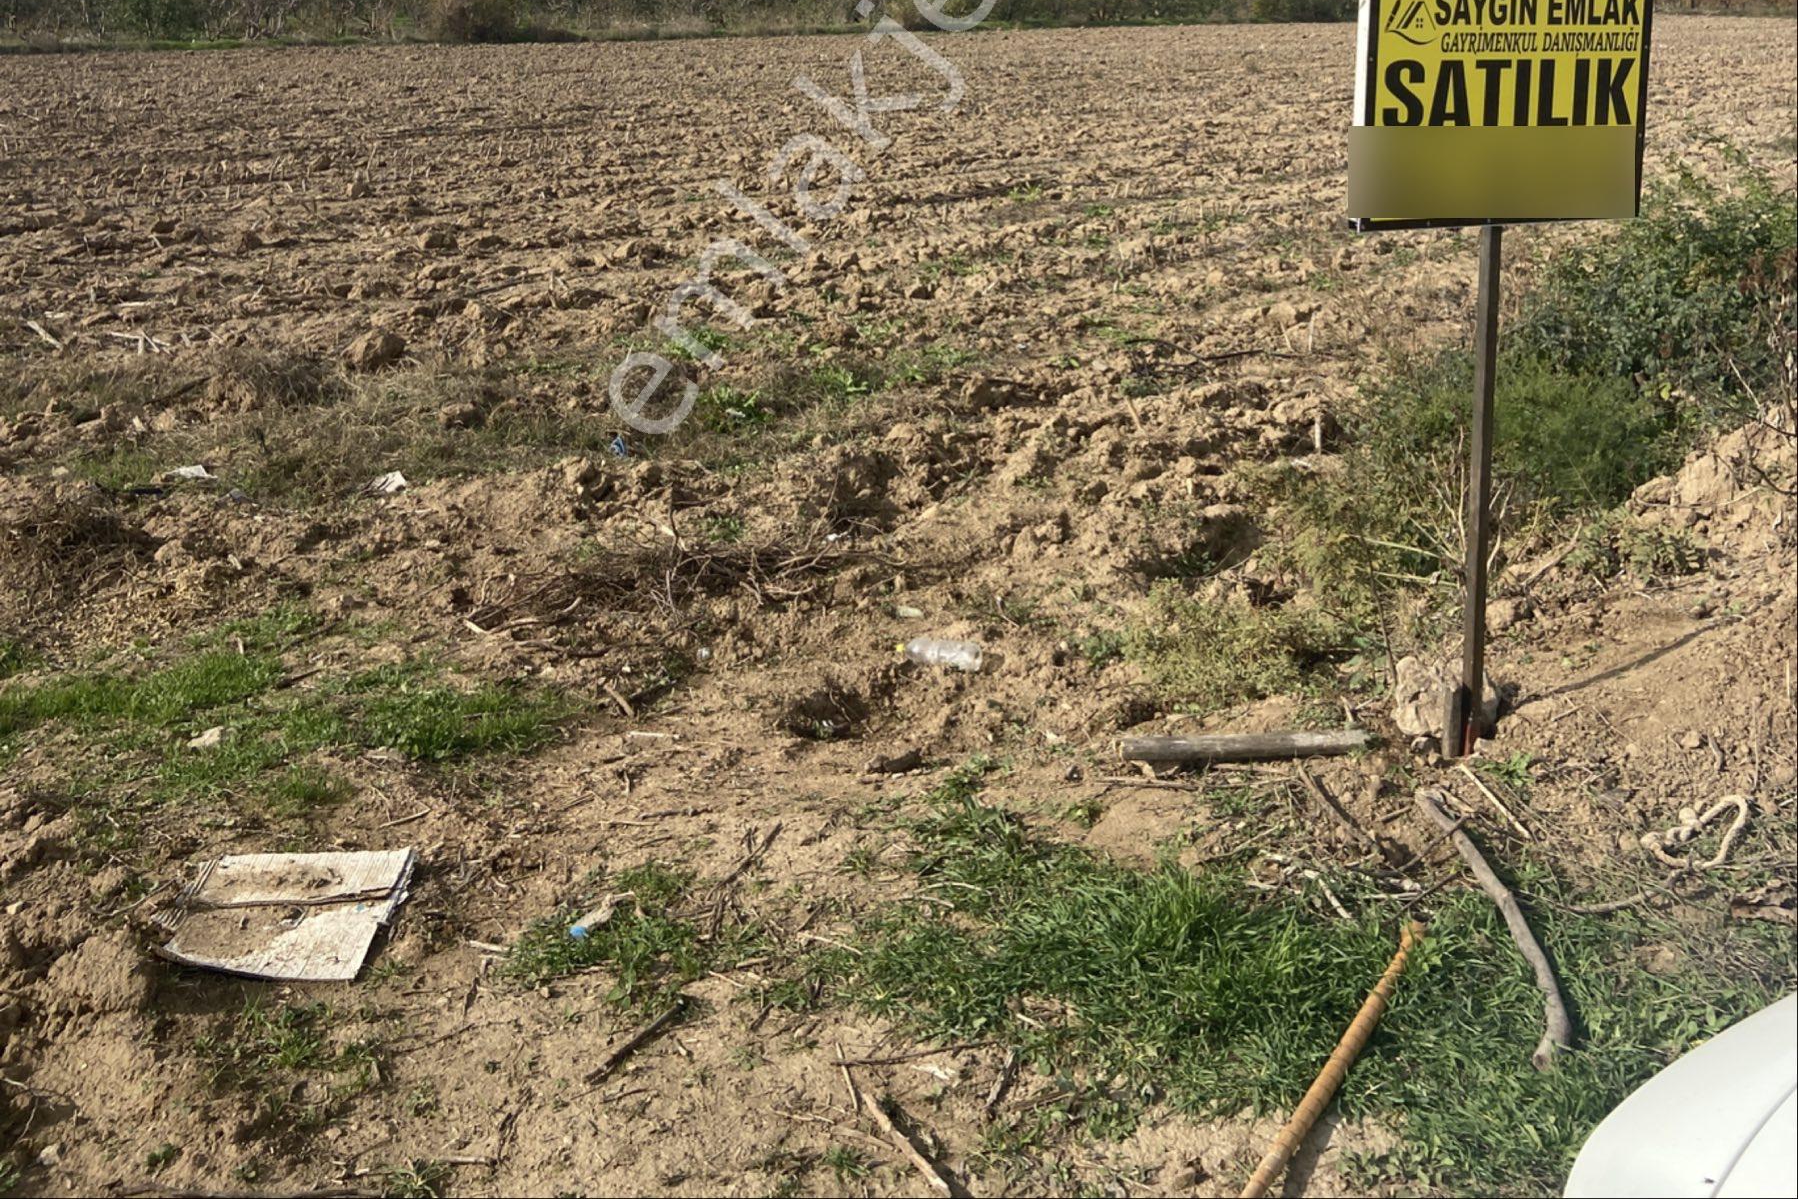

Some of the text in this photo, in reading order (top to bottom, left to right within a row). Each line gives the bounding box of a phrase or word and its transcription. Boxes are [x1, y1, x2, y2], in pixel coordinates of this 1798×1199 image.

[1441, 26, 1640, 58] GAYRİMENKUL DANIŞMANLIĞI
[1382, 58, 1636, 127] SATILIK
